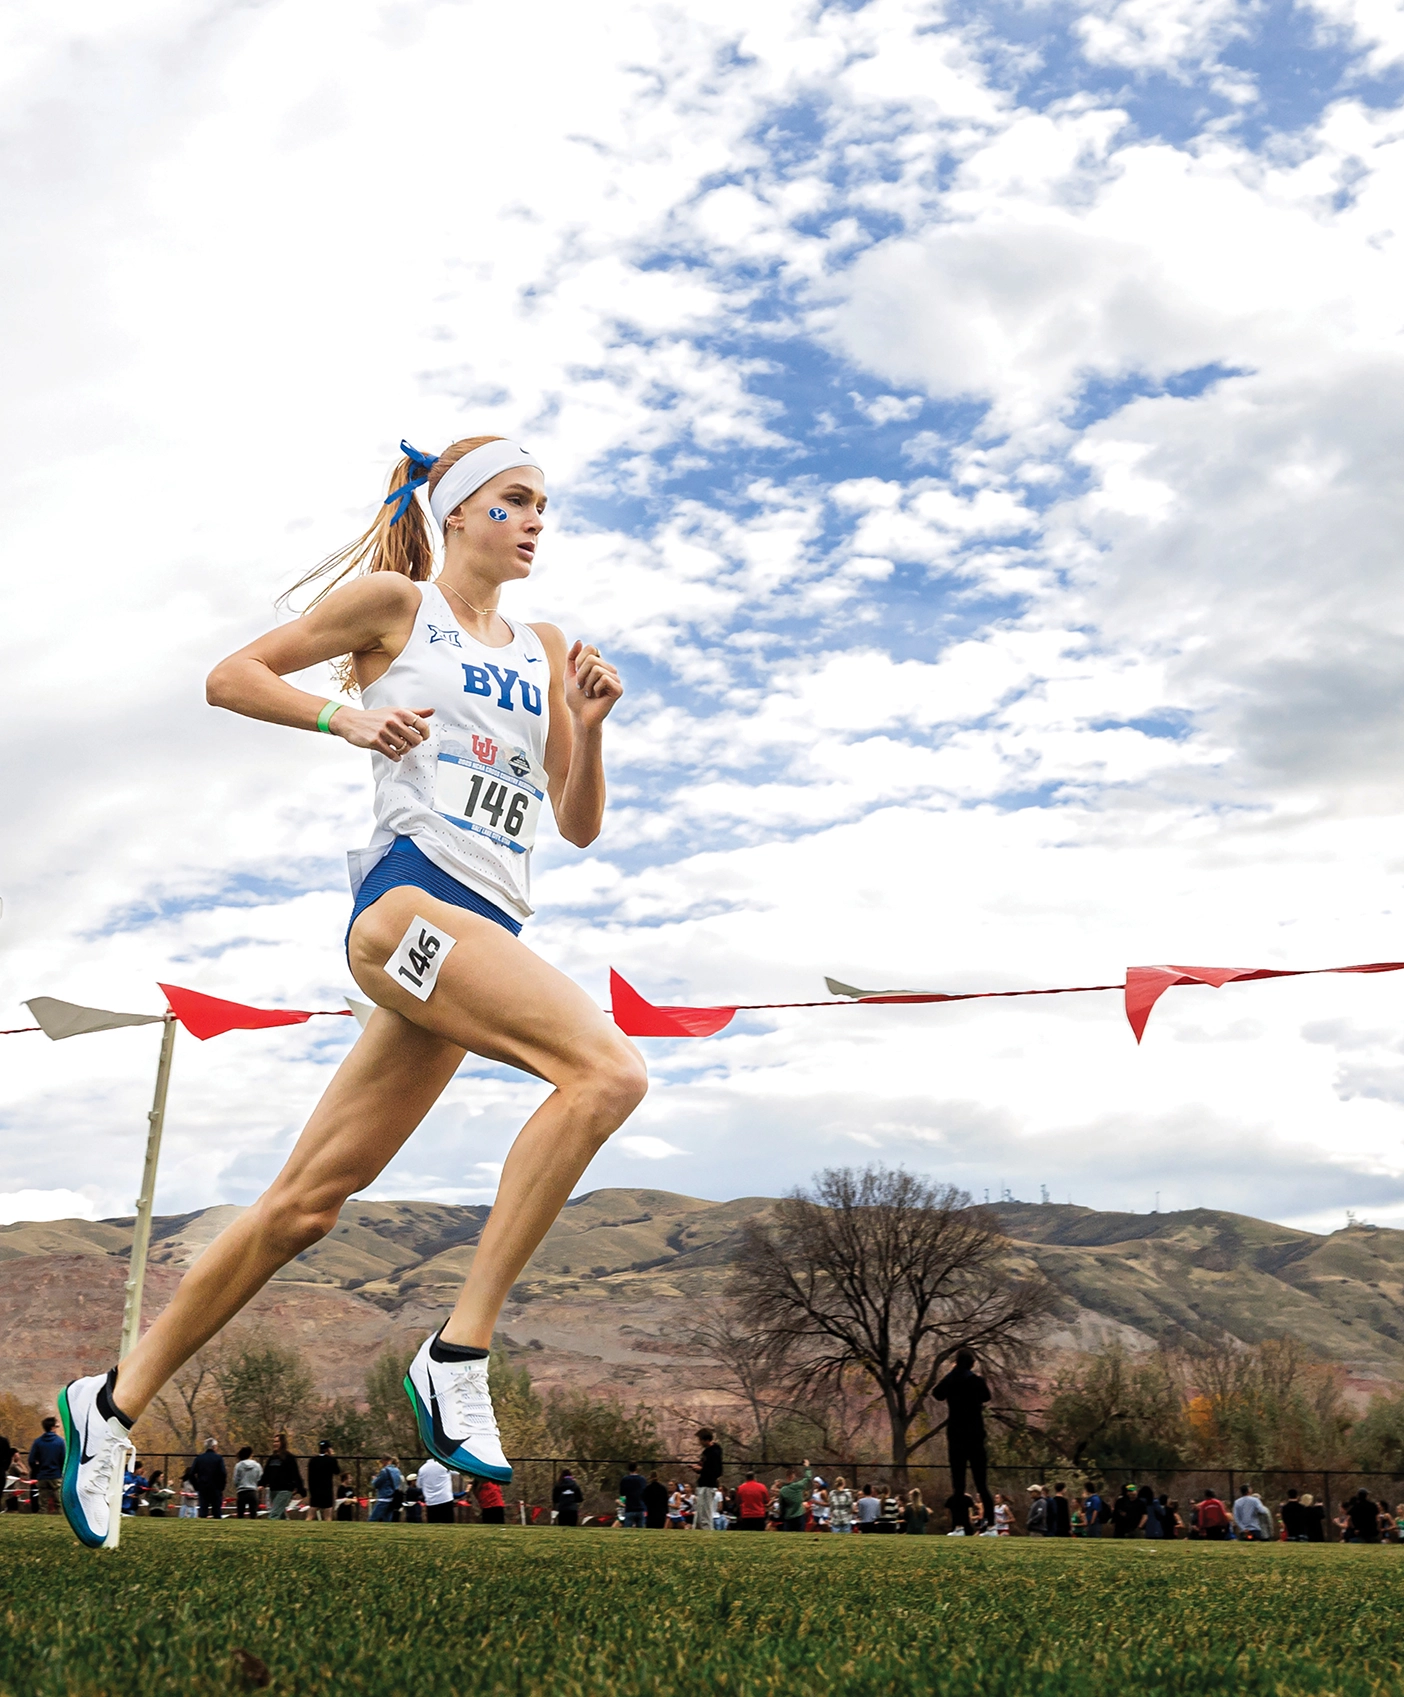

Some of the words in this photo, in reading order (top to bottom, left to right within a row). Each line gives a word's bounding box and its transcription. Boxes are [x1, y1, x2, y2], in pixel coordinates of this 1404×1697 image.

[461, 662, 542, 716] BYU
[463, 774, 529, 837] 146
[398, 928, 440, 988] 146
